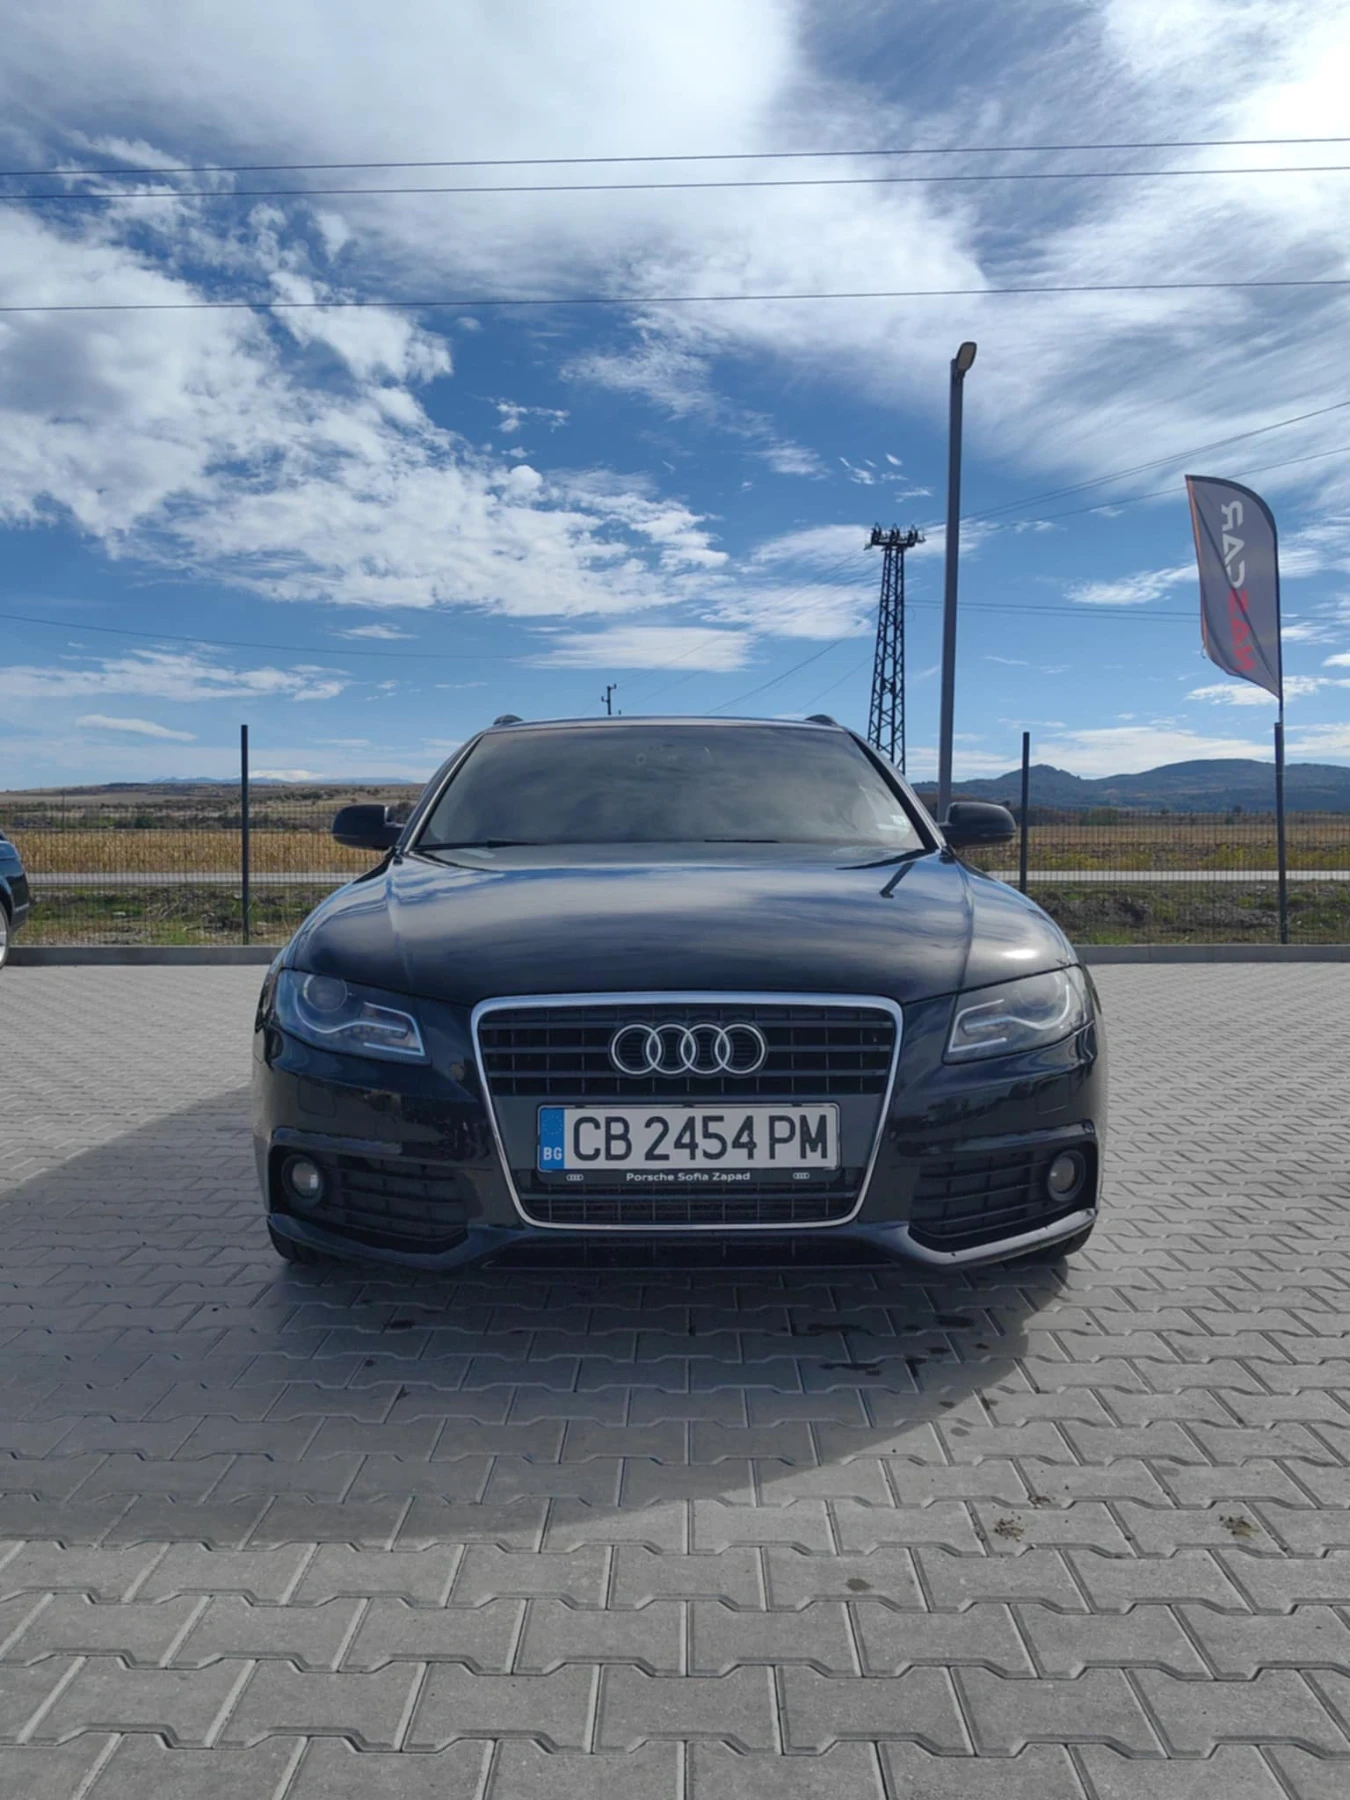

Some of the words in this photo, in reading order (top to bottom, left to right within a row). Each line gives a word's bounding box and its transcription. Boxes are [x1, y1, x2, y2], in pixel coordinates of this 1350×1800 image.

[572, 1116, 632, 1162] CB
[644, 1115, 757, 1161] 2454
[768, 1114, 829, 1161] PM
[543, 1147, 563, 1161] BG
[626, 1172, 675, 1182] Porsche
[677, 1172, 709, 1181] Sofia
[712, 1171, 751, 1183] Zapad
